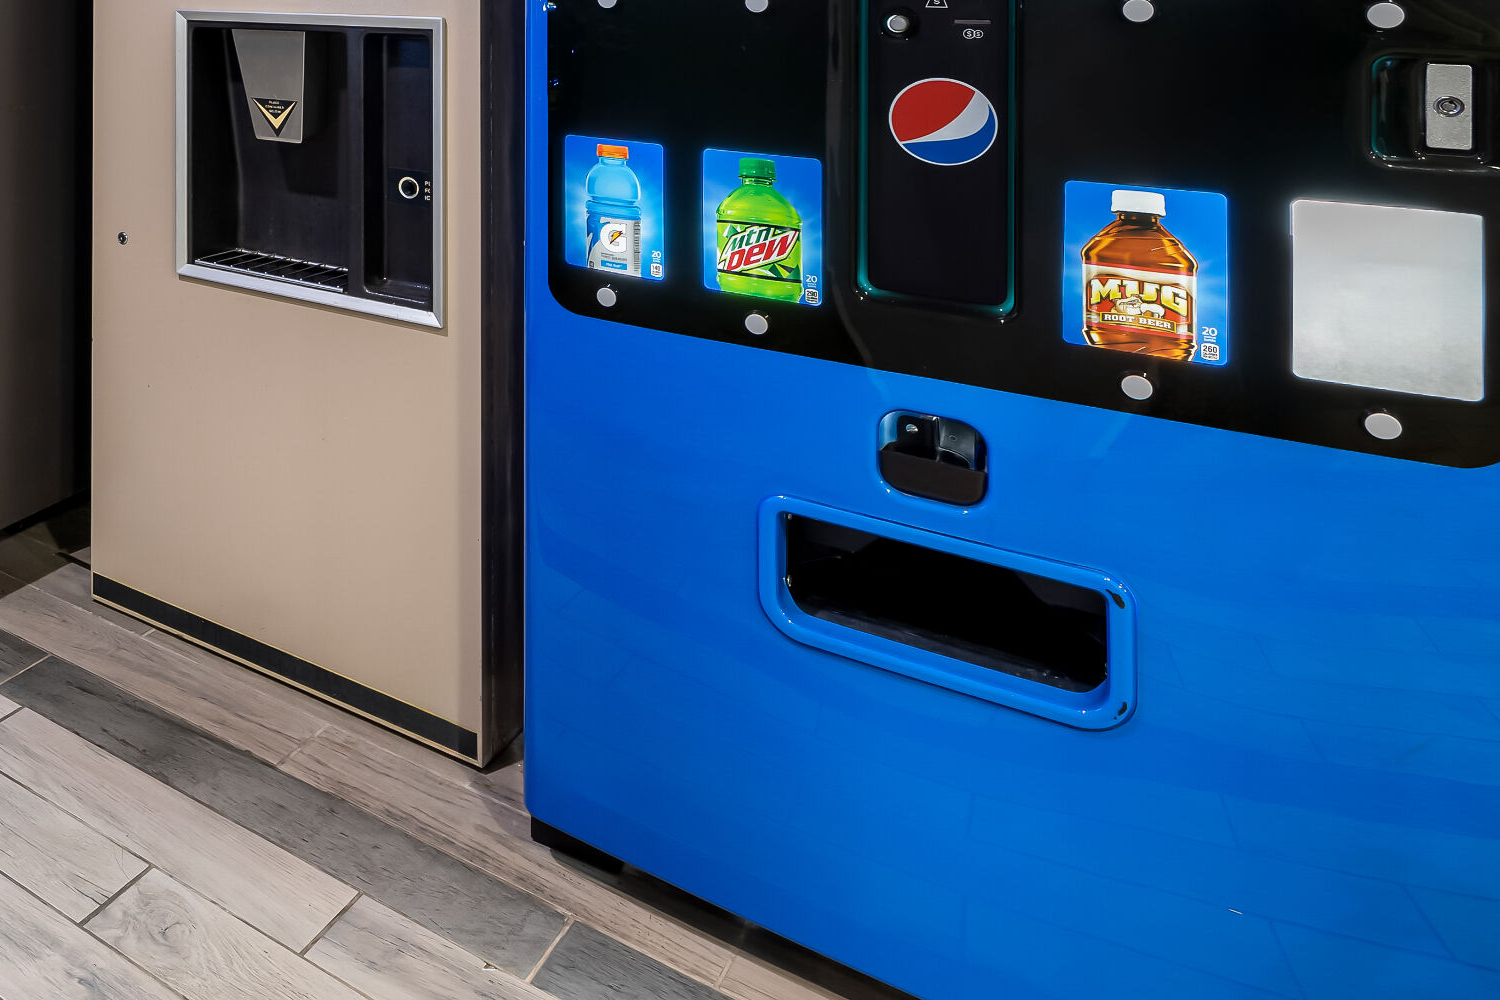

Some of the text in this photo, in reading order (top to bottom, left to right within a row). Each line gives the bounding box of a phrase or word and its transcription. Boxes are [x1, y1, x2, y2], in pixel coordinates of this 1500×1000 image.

[651, 250, 662, 258] 20
[805, 274, 818, 283] 20
[1090, 278, 1188, 318] MUG
[1103, 313, 1172, 329] ROOT BEER
[1201, 326, 1218, 337] 20
[1202, 345, 1218, 354] 260
